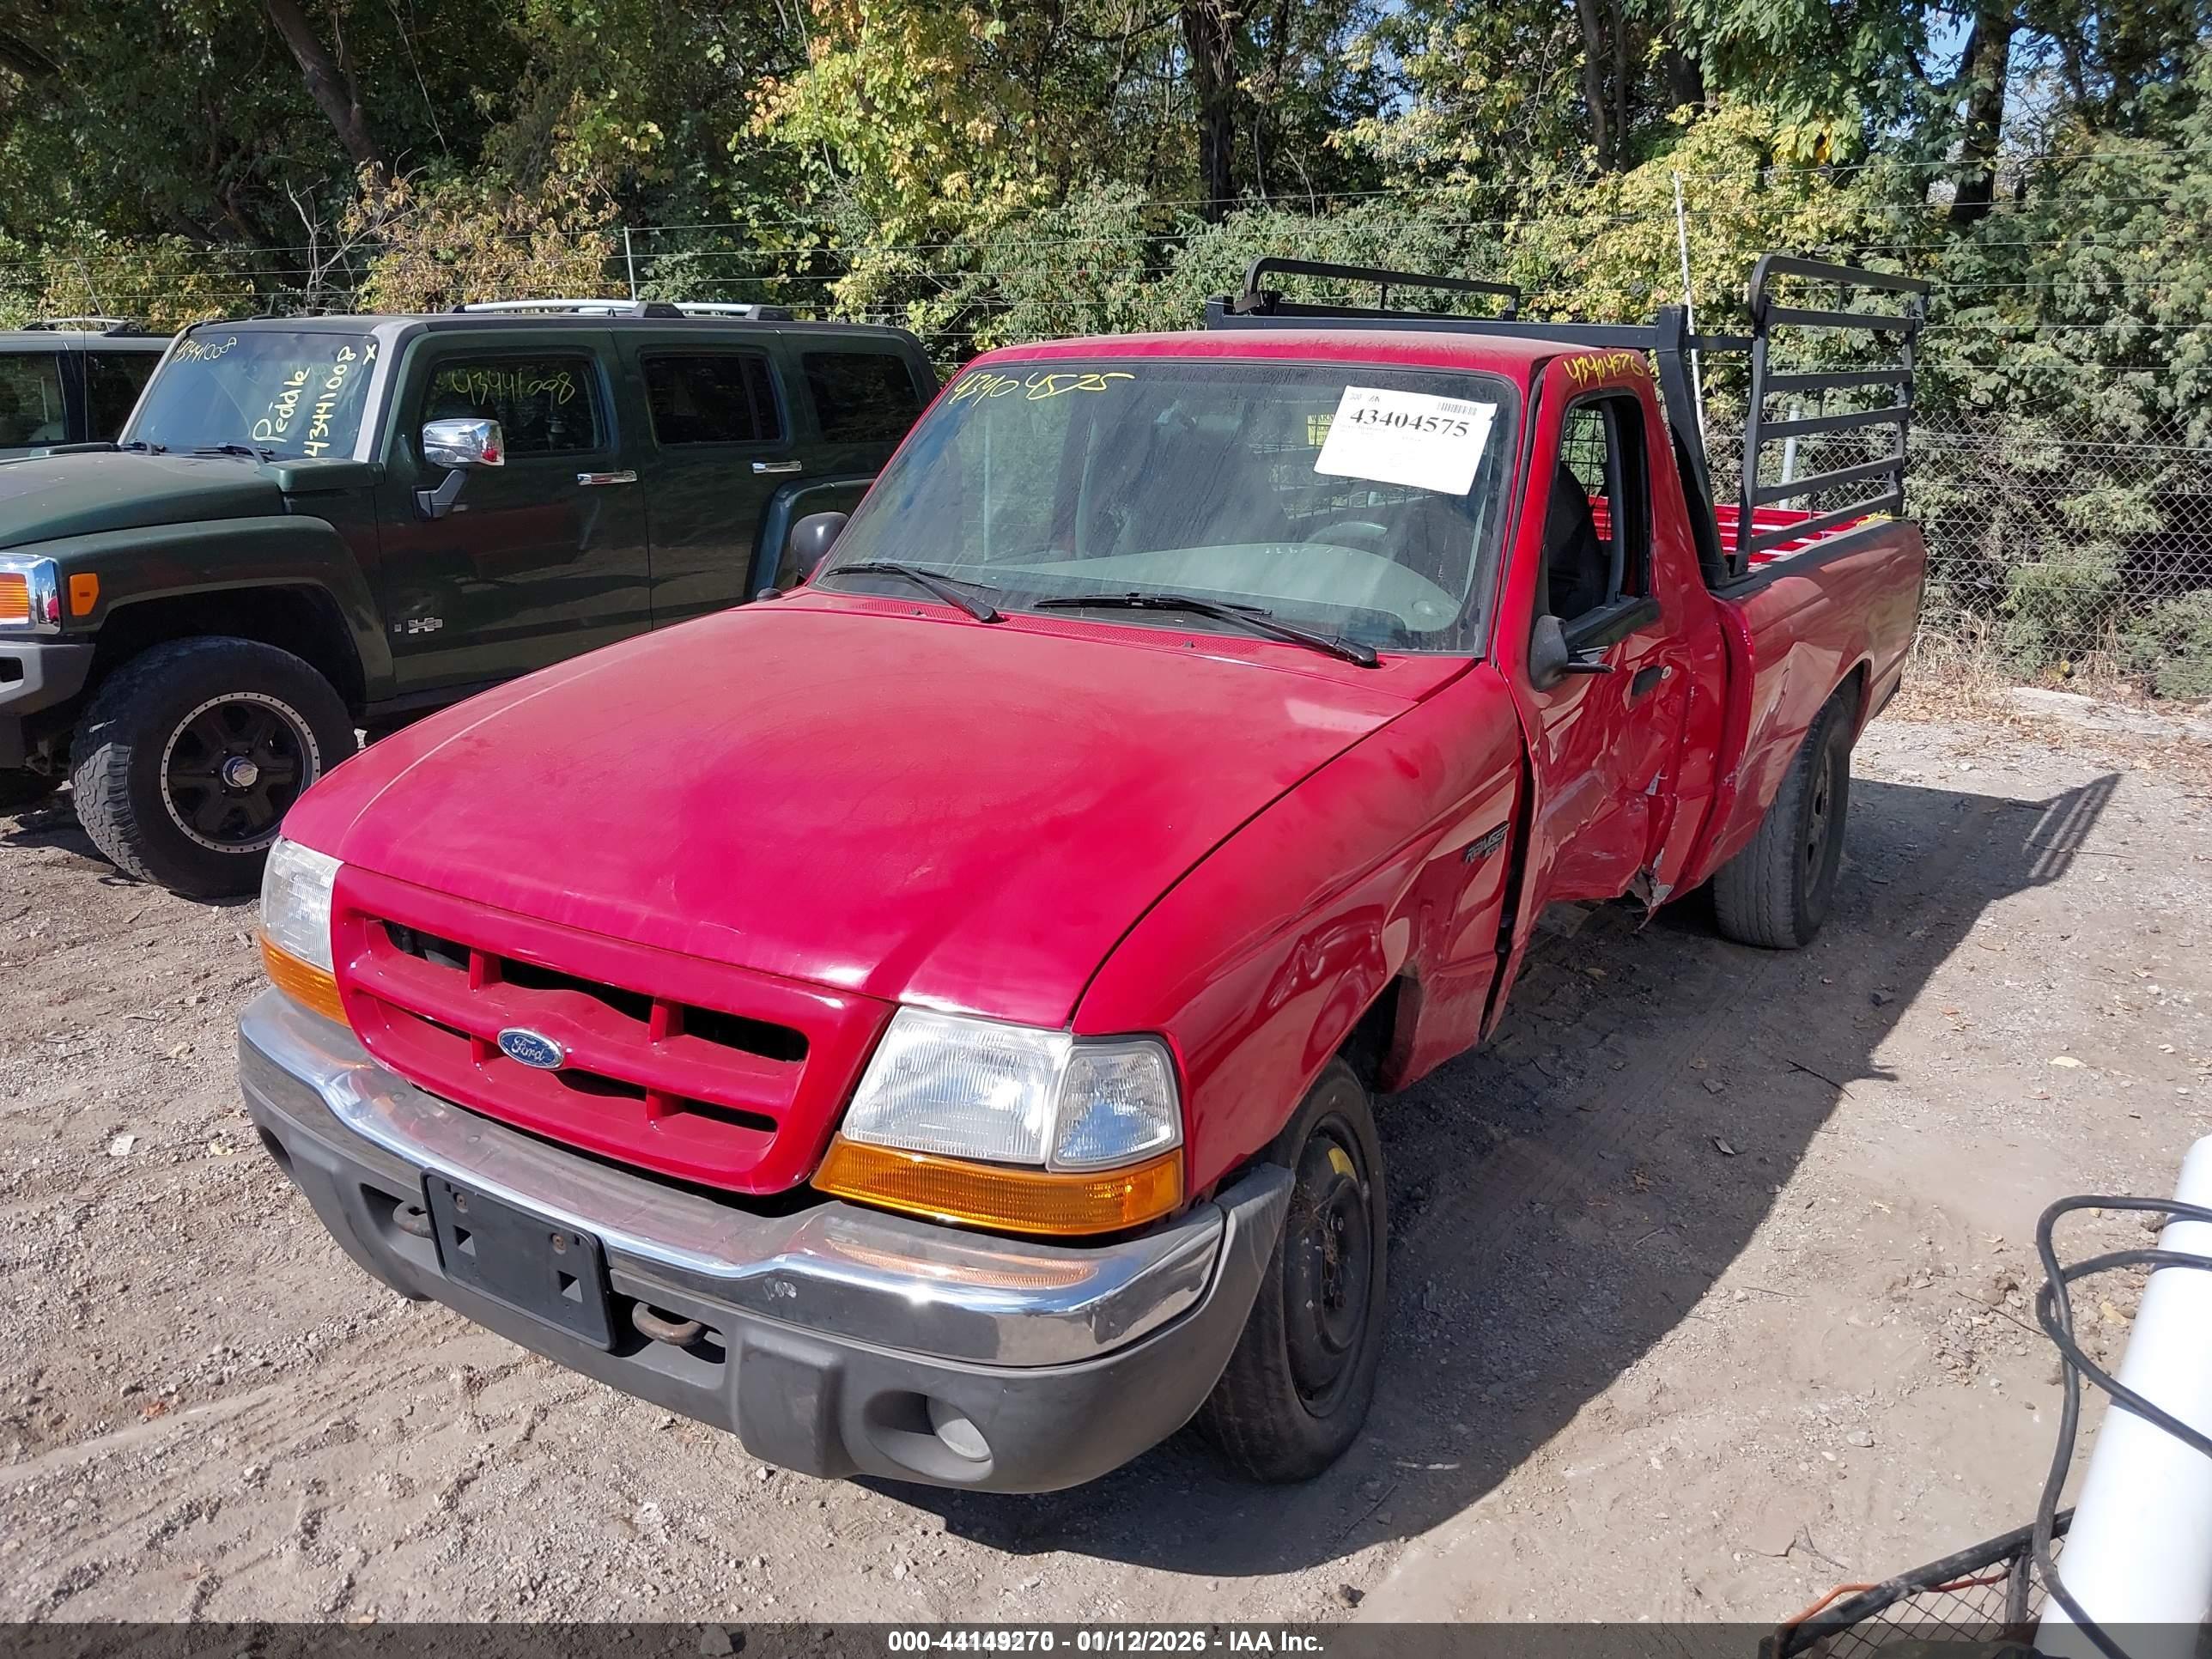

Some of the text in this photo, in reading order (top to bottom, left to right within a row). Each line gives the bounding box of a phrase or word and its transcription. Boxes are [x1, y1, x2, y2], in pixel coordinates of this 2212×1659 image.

[303, 345, 357, 458] 43441008
[1349, 408, 1471, 437] 43404575
[512, 1036, 544, 1063] Ford
